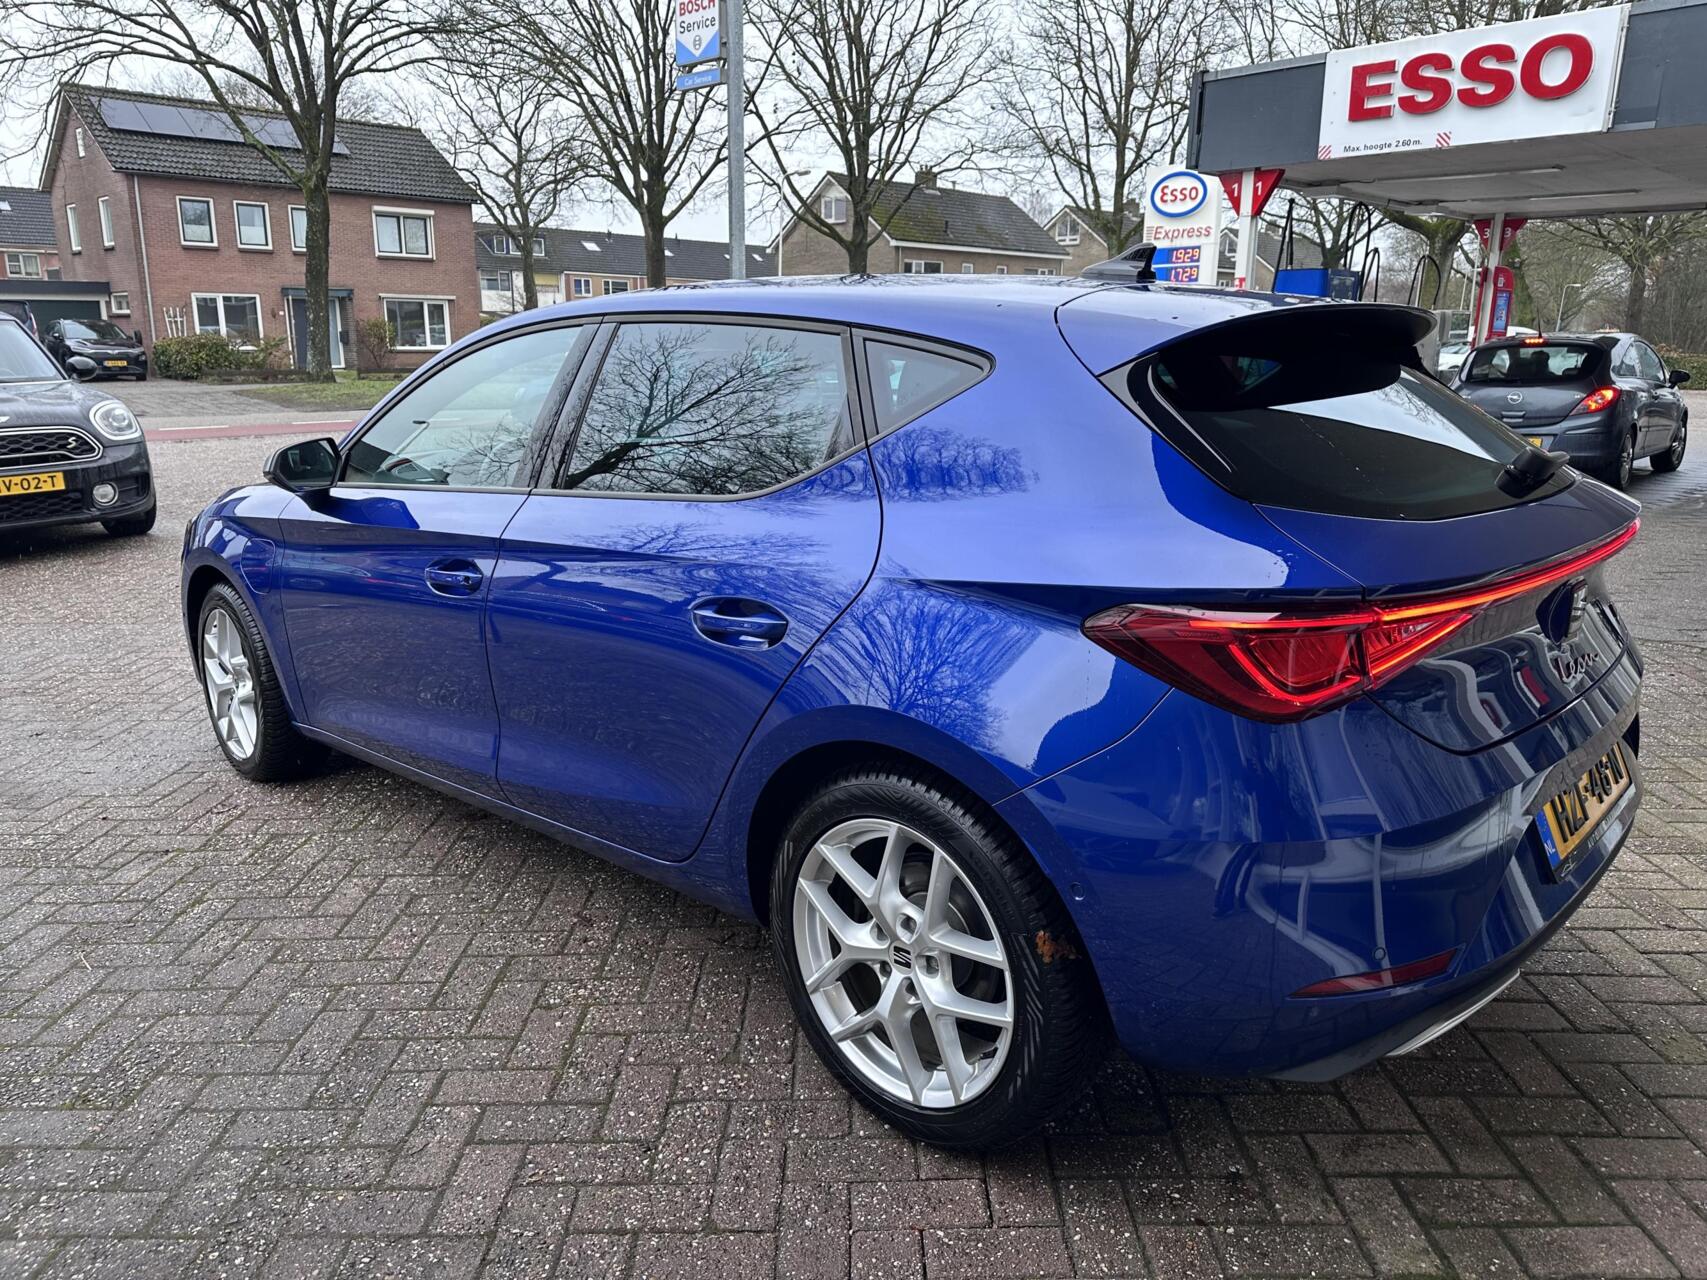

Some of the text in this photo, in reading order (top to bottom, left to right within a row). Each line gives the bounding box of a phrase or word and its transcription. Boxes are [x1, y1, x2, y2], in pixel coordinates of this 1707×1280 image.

[679, 0, 716, 16] BOSCH
[679, 16, 716, 34] Service
[1348, 33, 1594, 122] ESSO
[1343, 138, 1423, 153] Max. hoogte 2.60 m.
[1160, 185, 1199, 204] Esso
[1232, 183, 1239, 197] 1
[1255, 180, 1263, 196] 1
[1153, 225, 1213, 241] Express
[1483, 228, 1490, 238] 3
[1504, 227, 1512, 237] 3
[66, 436, 77, 449] S
[0, 475, 57, 493] V-02-T
